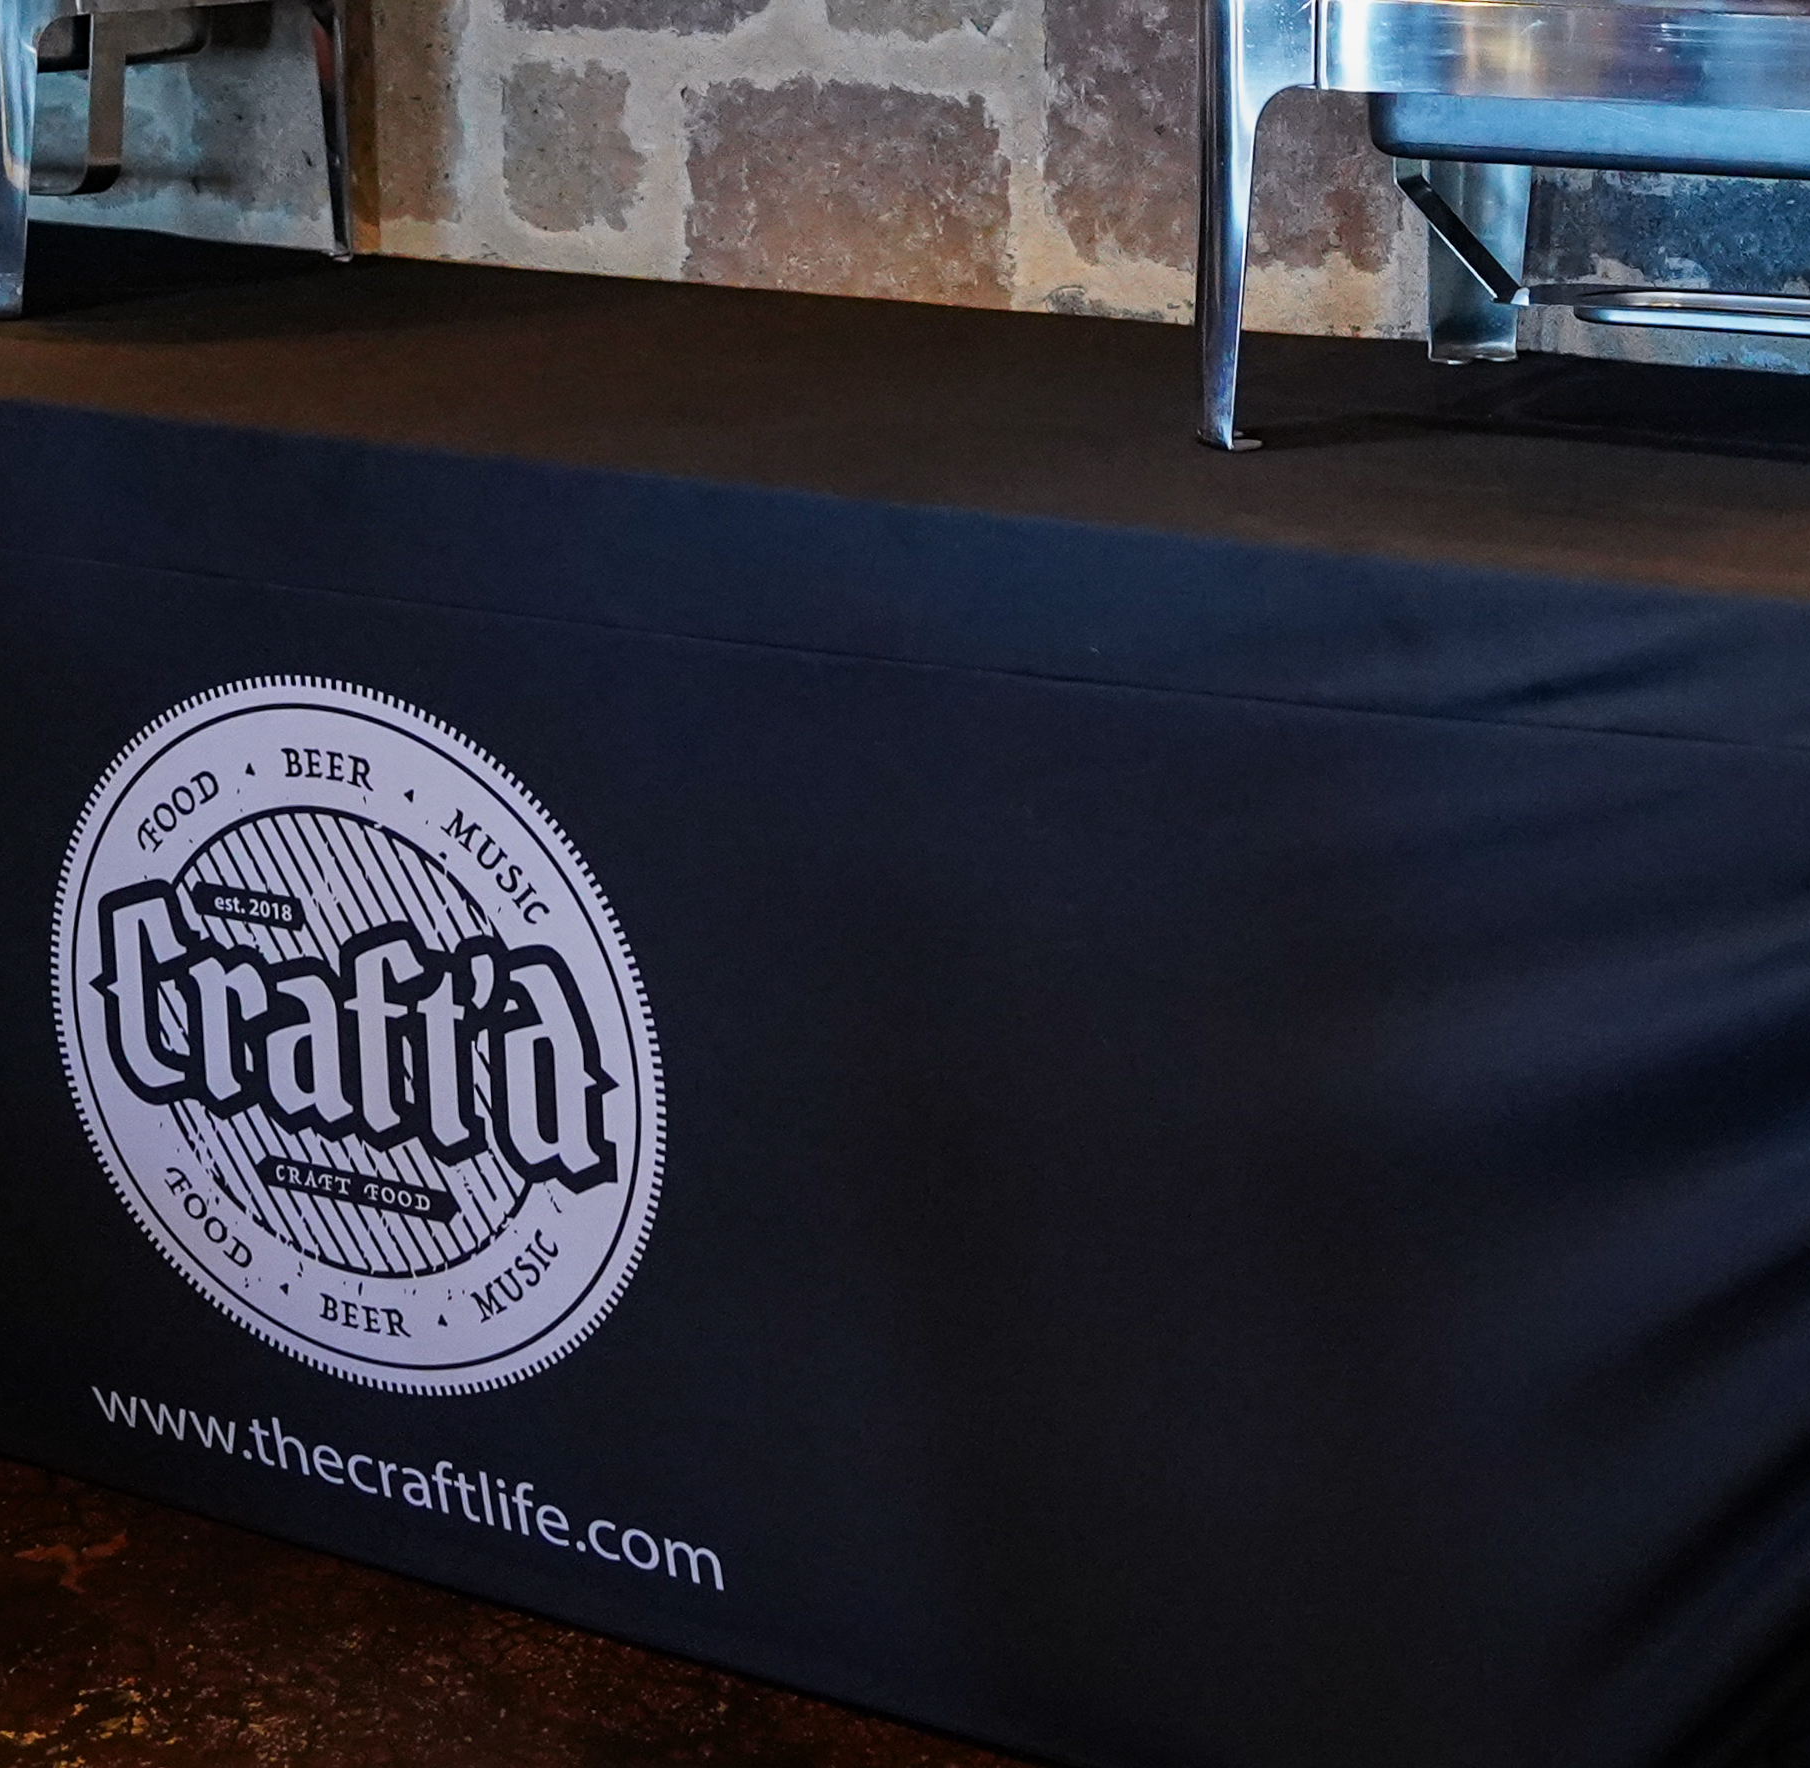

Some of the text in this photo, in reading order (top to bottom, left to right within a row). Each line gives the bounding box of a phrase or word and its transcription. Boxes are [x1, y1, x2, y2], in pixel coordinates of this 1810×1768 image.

[137, 748, 551, 925] FOOD BEER MUSIC
[214, 894, 293, 922] est. 2018
[165, 1166, 560, 1338] FOOD BEER MUSIC
[275, 1164, 432, 1212] CRAFT FOOD
[92, 1385, 725, 1591] www.thecraftlife.com
